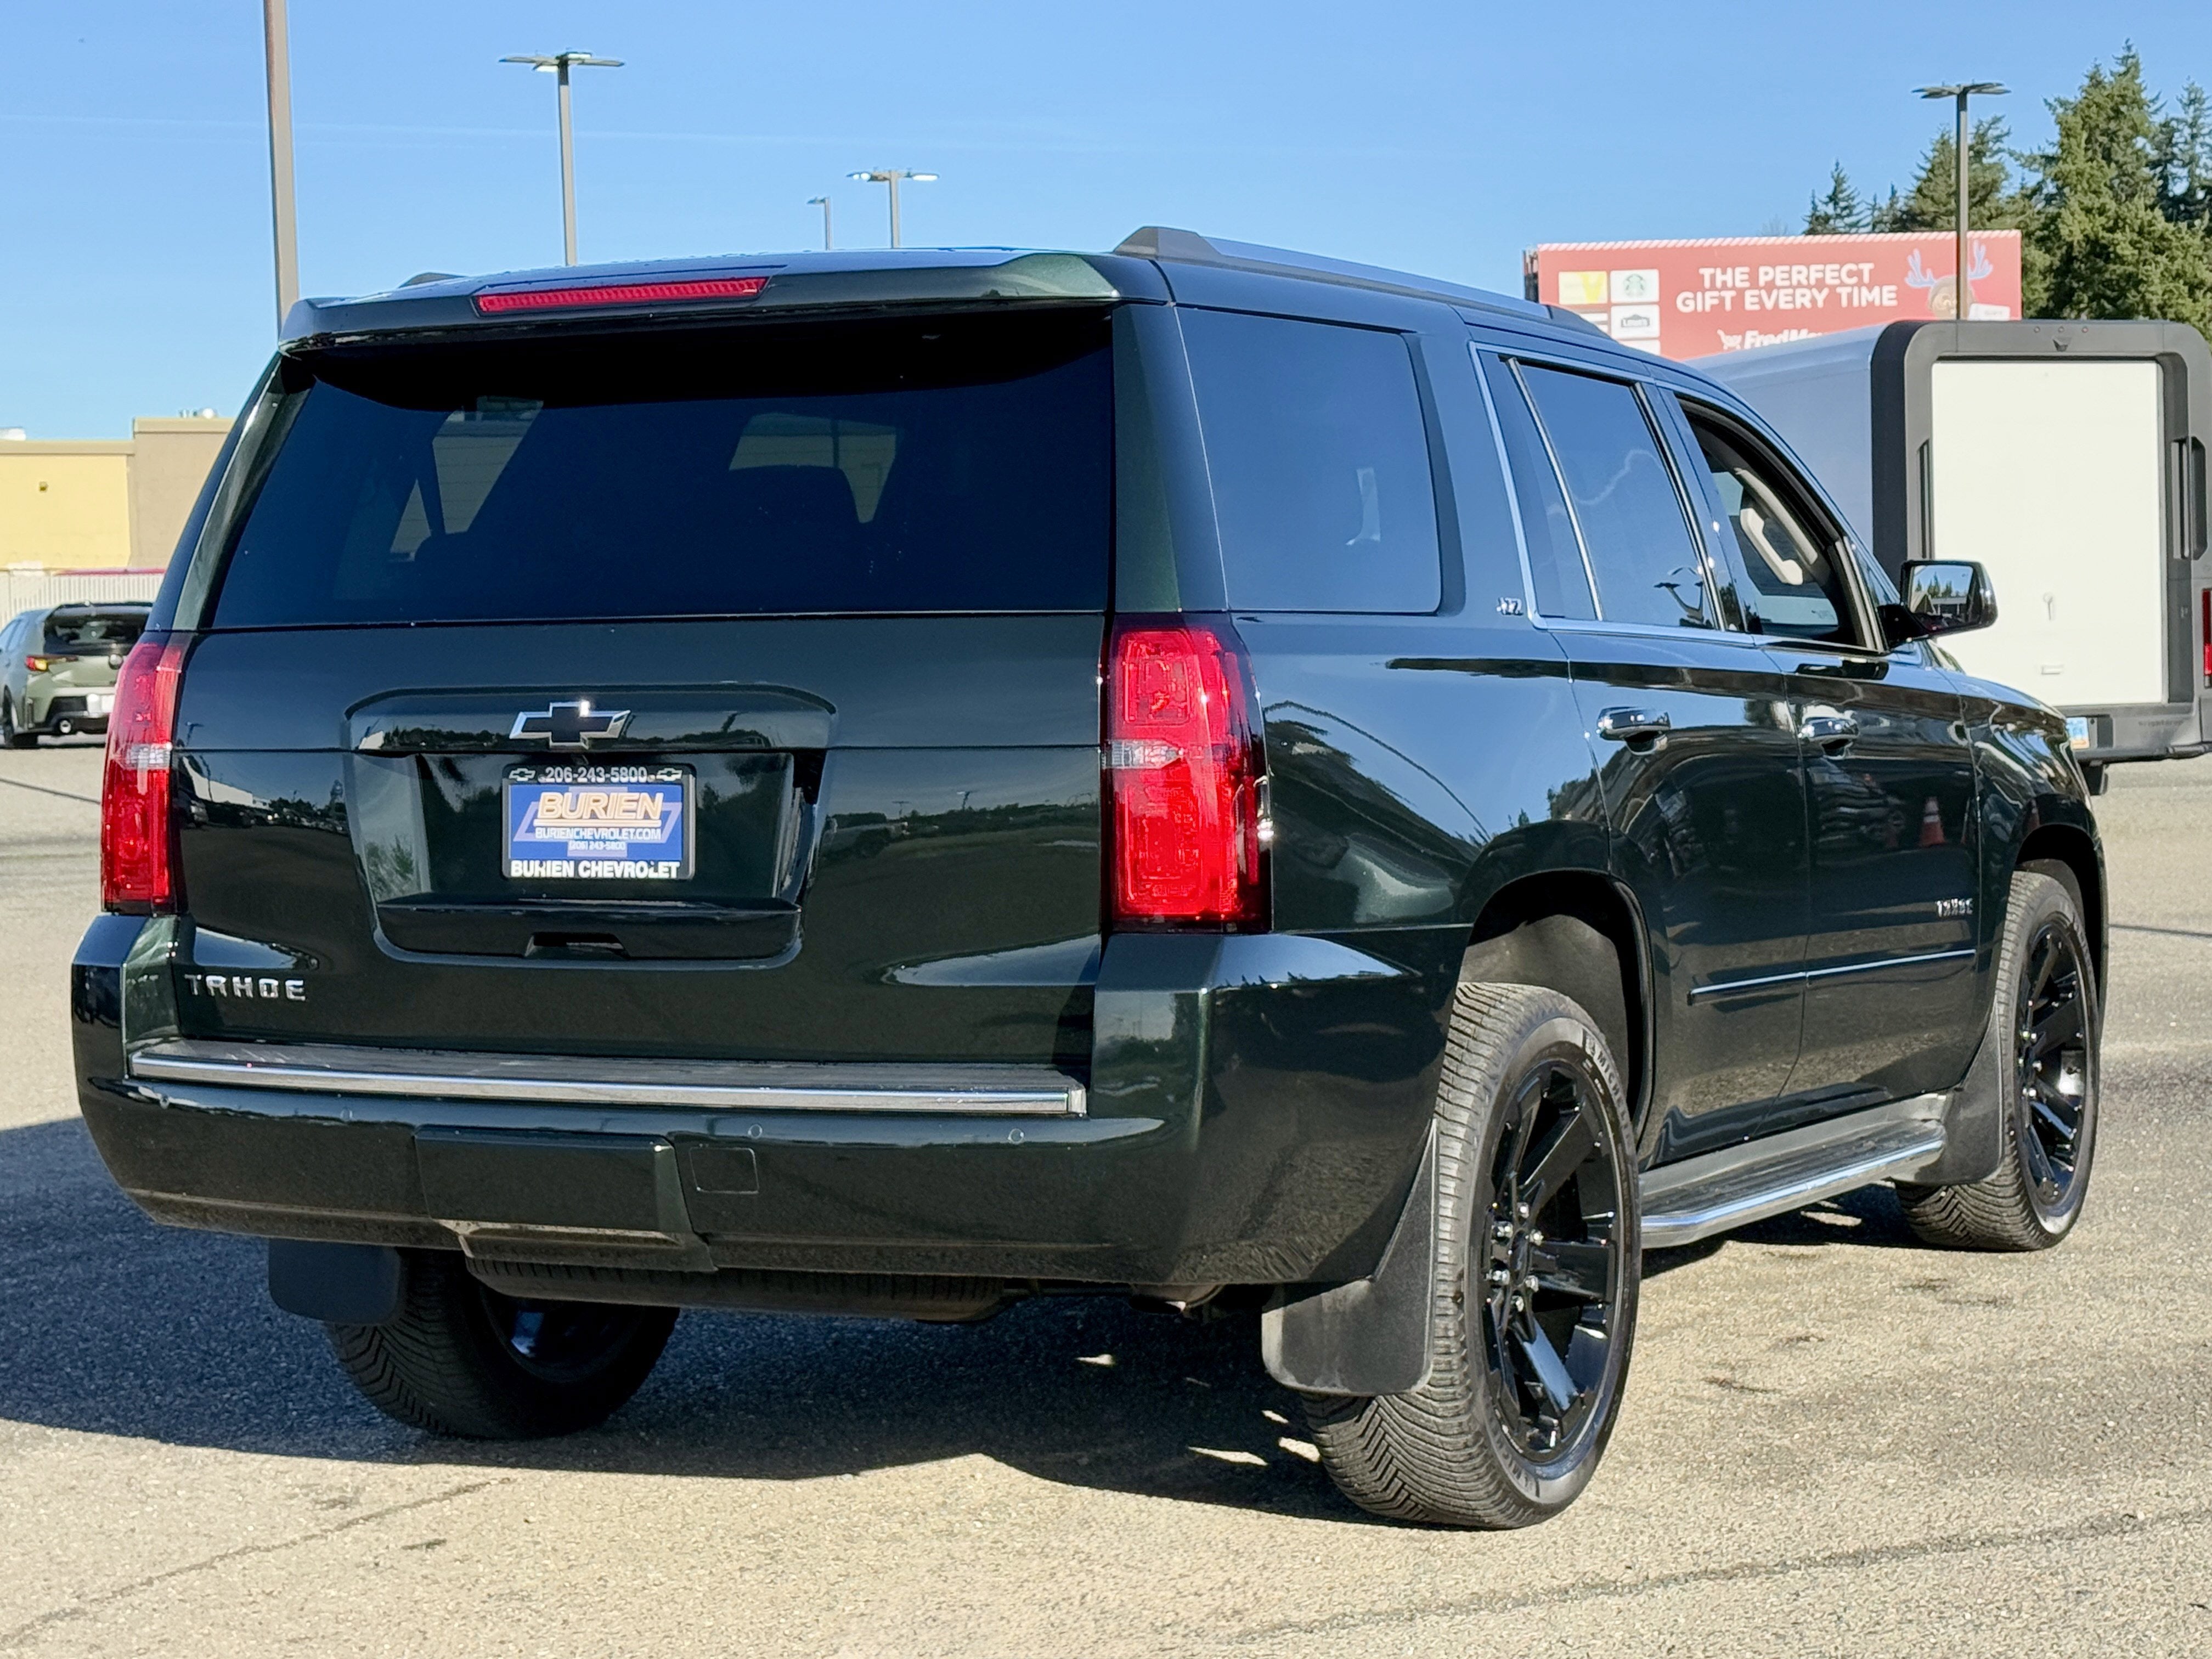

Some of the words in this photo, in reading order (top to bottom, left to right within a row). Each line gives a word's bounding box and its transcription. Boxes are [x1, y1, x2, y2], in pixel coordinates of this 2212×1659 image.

[1699, 266, 1751, 289] THE
[1758, 262, 1875, 287] PERFECT
[1676, 290, 1737, 313] GIFT
[1744, 287, 1830, 311] EVERY
[1836, 285, 1898, 308] TIME
[545, 766, 648, 783] 206-243-5800
[537, 792, 664, 820] BURIEN
[535, 827, 661, 840] BURIENCHEVROLET.COM
[511, 860, 574, 878] BURIEN
[578, 860, 681, 878] CHEVROLET
[184, 974, 306, 1001] TAHOE
